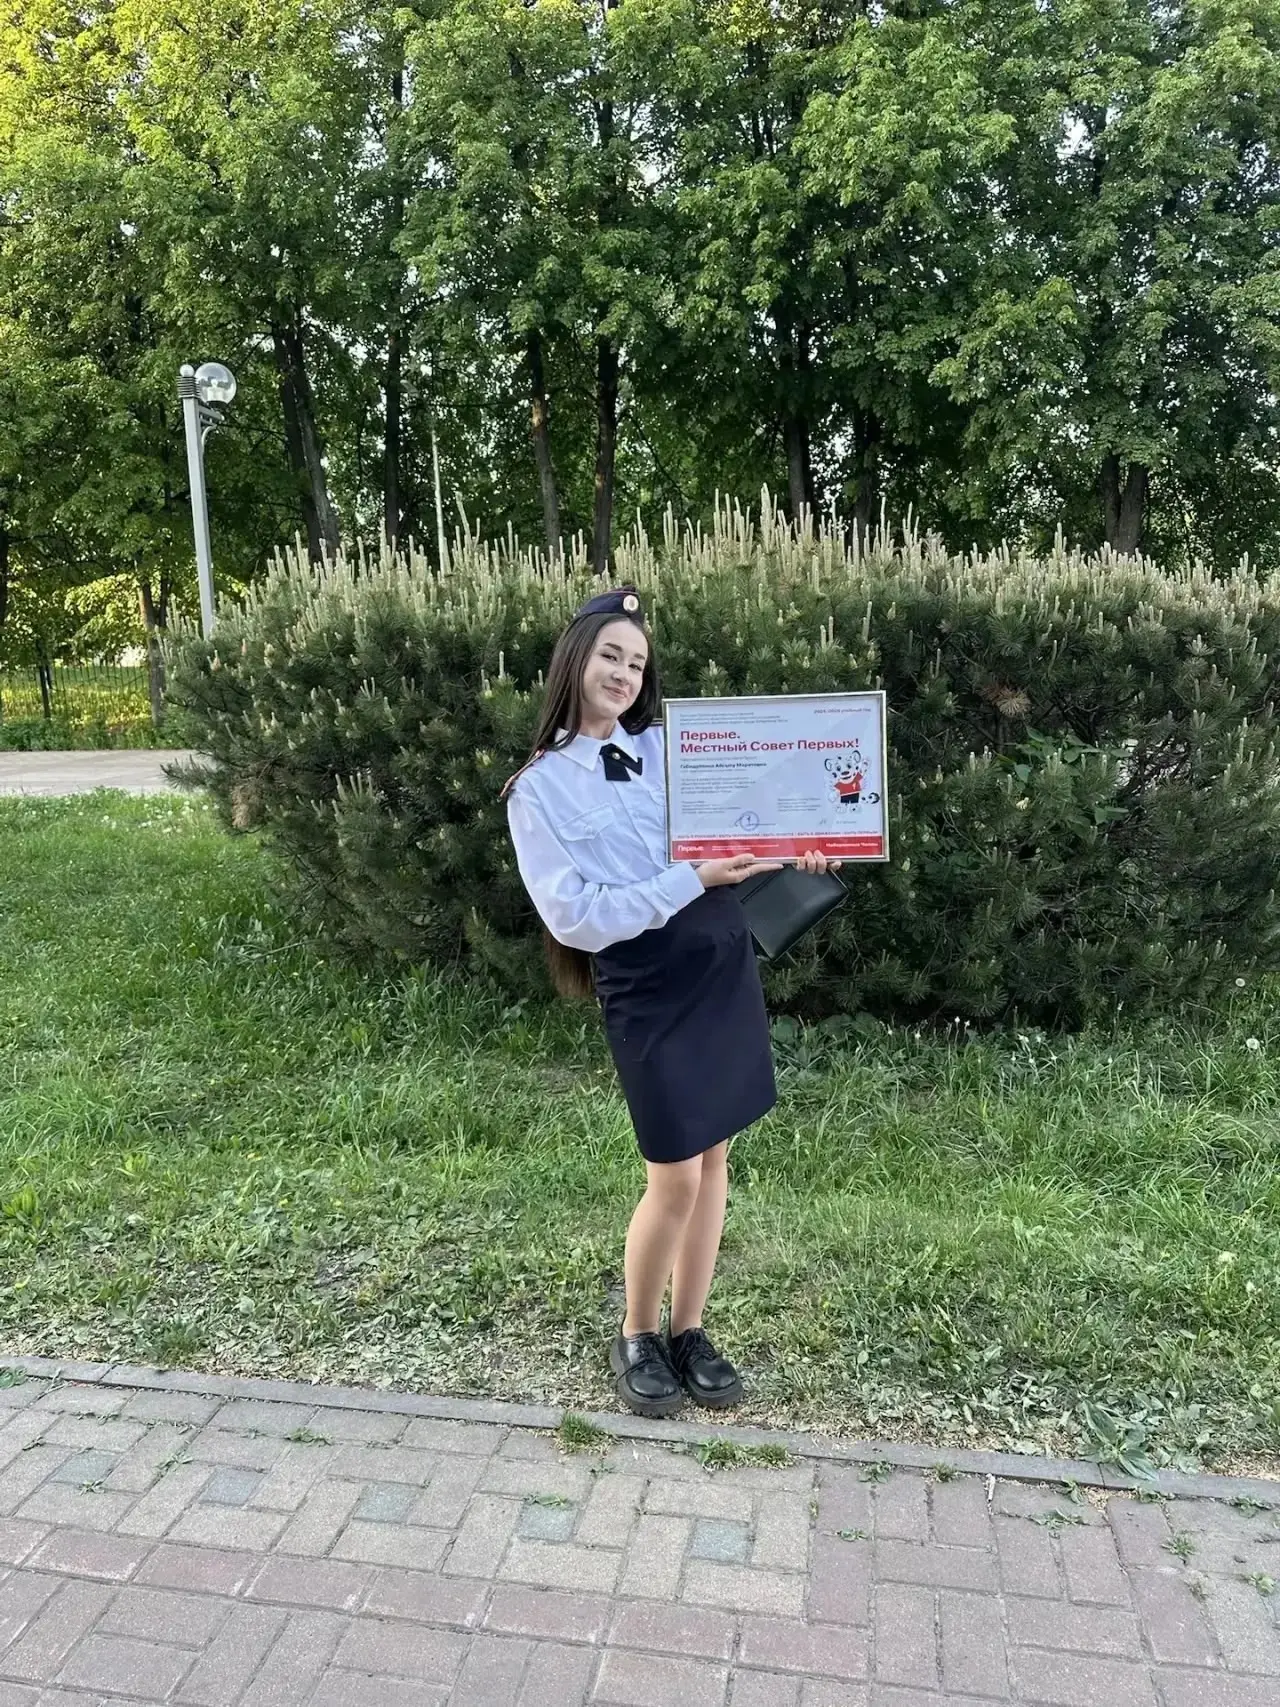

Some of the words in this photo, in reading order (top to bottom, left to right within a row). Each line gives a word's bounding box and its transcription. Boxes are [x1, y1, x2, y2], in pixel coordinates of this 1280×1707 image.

[680, 730, 741, 742] Первые.
[680, 741, 748, 754] Местный
[750, 740, 795, 752] Совет
[797, 738, 860, 751] Первых!
